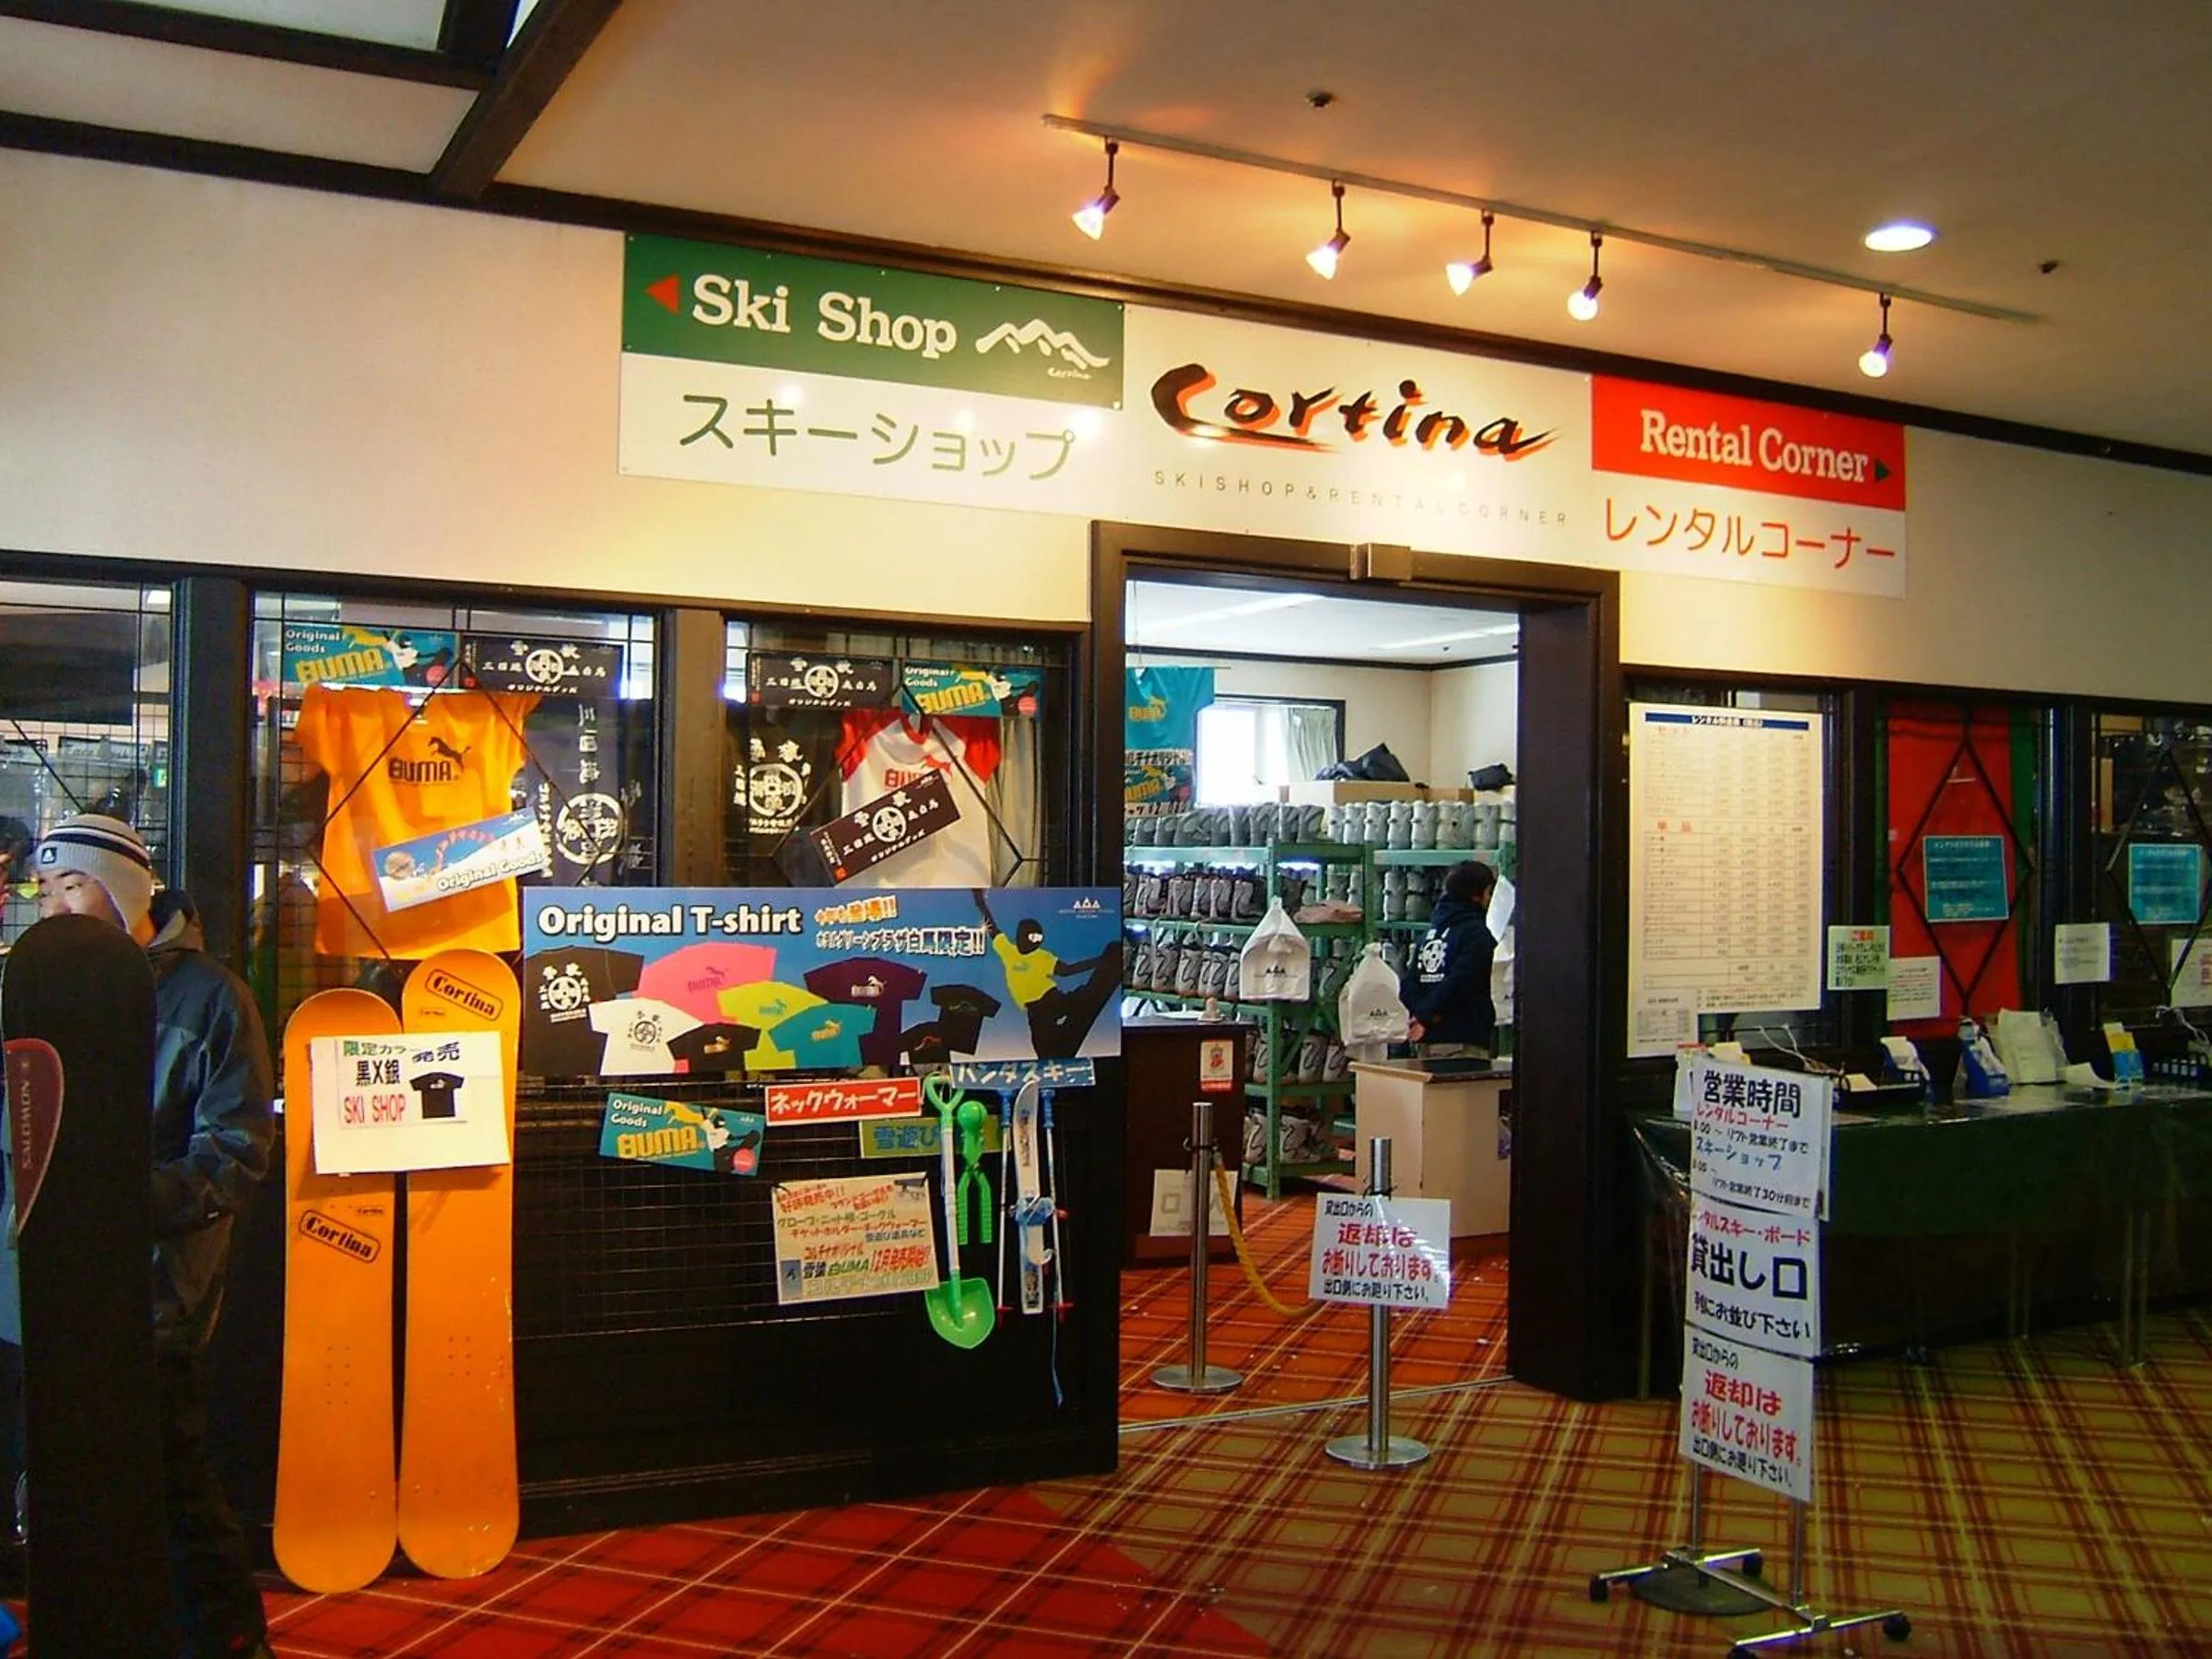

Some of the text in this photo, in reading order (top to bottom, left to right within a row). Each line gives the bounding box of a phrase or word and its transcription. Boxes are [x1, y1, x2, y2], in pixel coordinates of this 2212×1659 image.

[693, 274, 958, 360] Ski Shop
[1151, 363, 1563, 461] Cortina
[680, 394, 1077, 481] スキーショップ
[1641, 409, 1867, 483] Rental Corner
[1606, 498, 1895, 569] レンタルコーナー
[286, 629, 340, 642] Original
[286, 643, 325, 653] Goods
[296, 648, 385, 685] BUMA
[904, 665, 949, 677] Original
[904, 677, 937, 688] Goods
[387, 756, 453, 782] BUMA
[437, 851, 543, 891] Original Goods
[537, 905, 803, 941] Original T-shirt
[431, 974, 498, 1019] Cortina
[344, 1093, 406, 1124] SKI SHOP
[613, 1100, 663, 1115] Original
[771, 1087, 916, 1114] ネックウォーマー
[1703, 1069, 1802, 1118] 営業時間
[20, 1079, 33, 1169] SALOMON
[611, 1113, 648, 1127] Goods
[1697, 1102, 1789, 1131] レンタルコーナー
[618, 1126, 698, 1159] BUMA
[1696, 1136, 1783, 1171] スキーショップ
[304, 1215, 373, 1260] Cortina
[1338, 1223, 1418, 1248] 返却は
[1699, 1210, 1811, 1246] タルスキー・ボード
[1691, 1232, 1807, 1300] 貸出し口
[1705, 1370, 1782, 1416] 返却は
